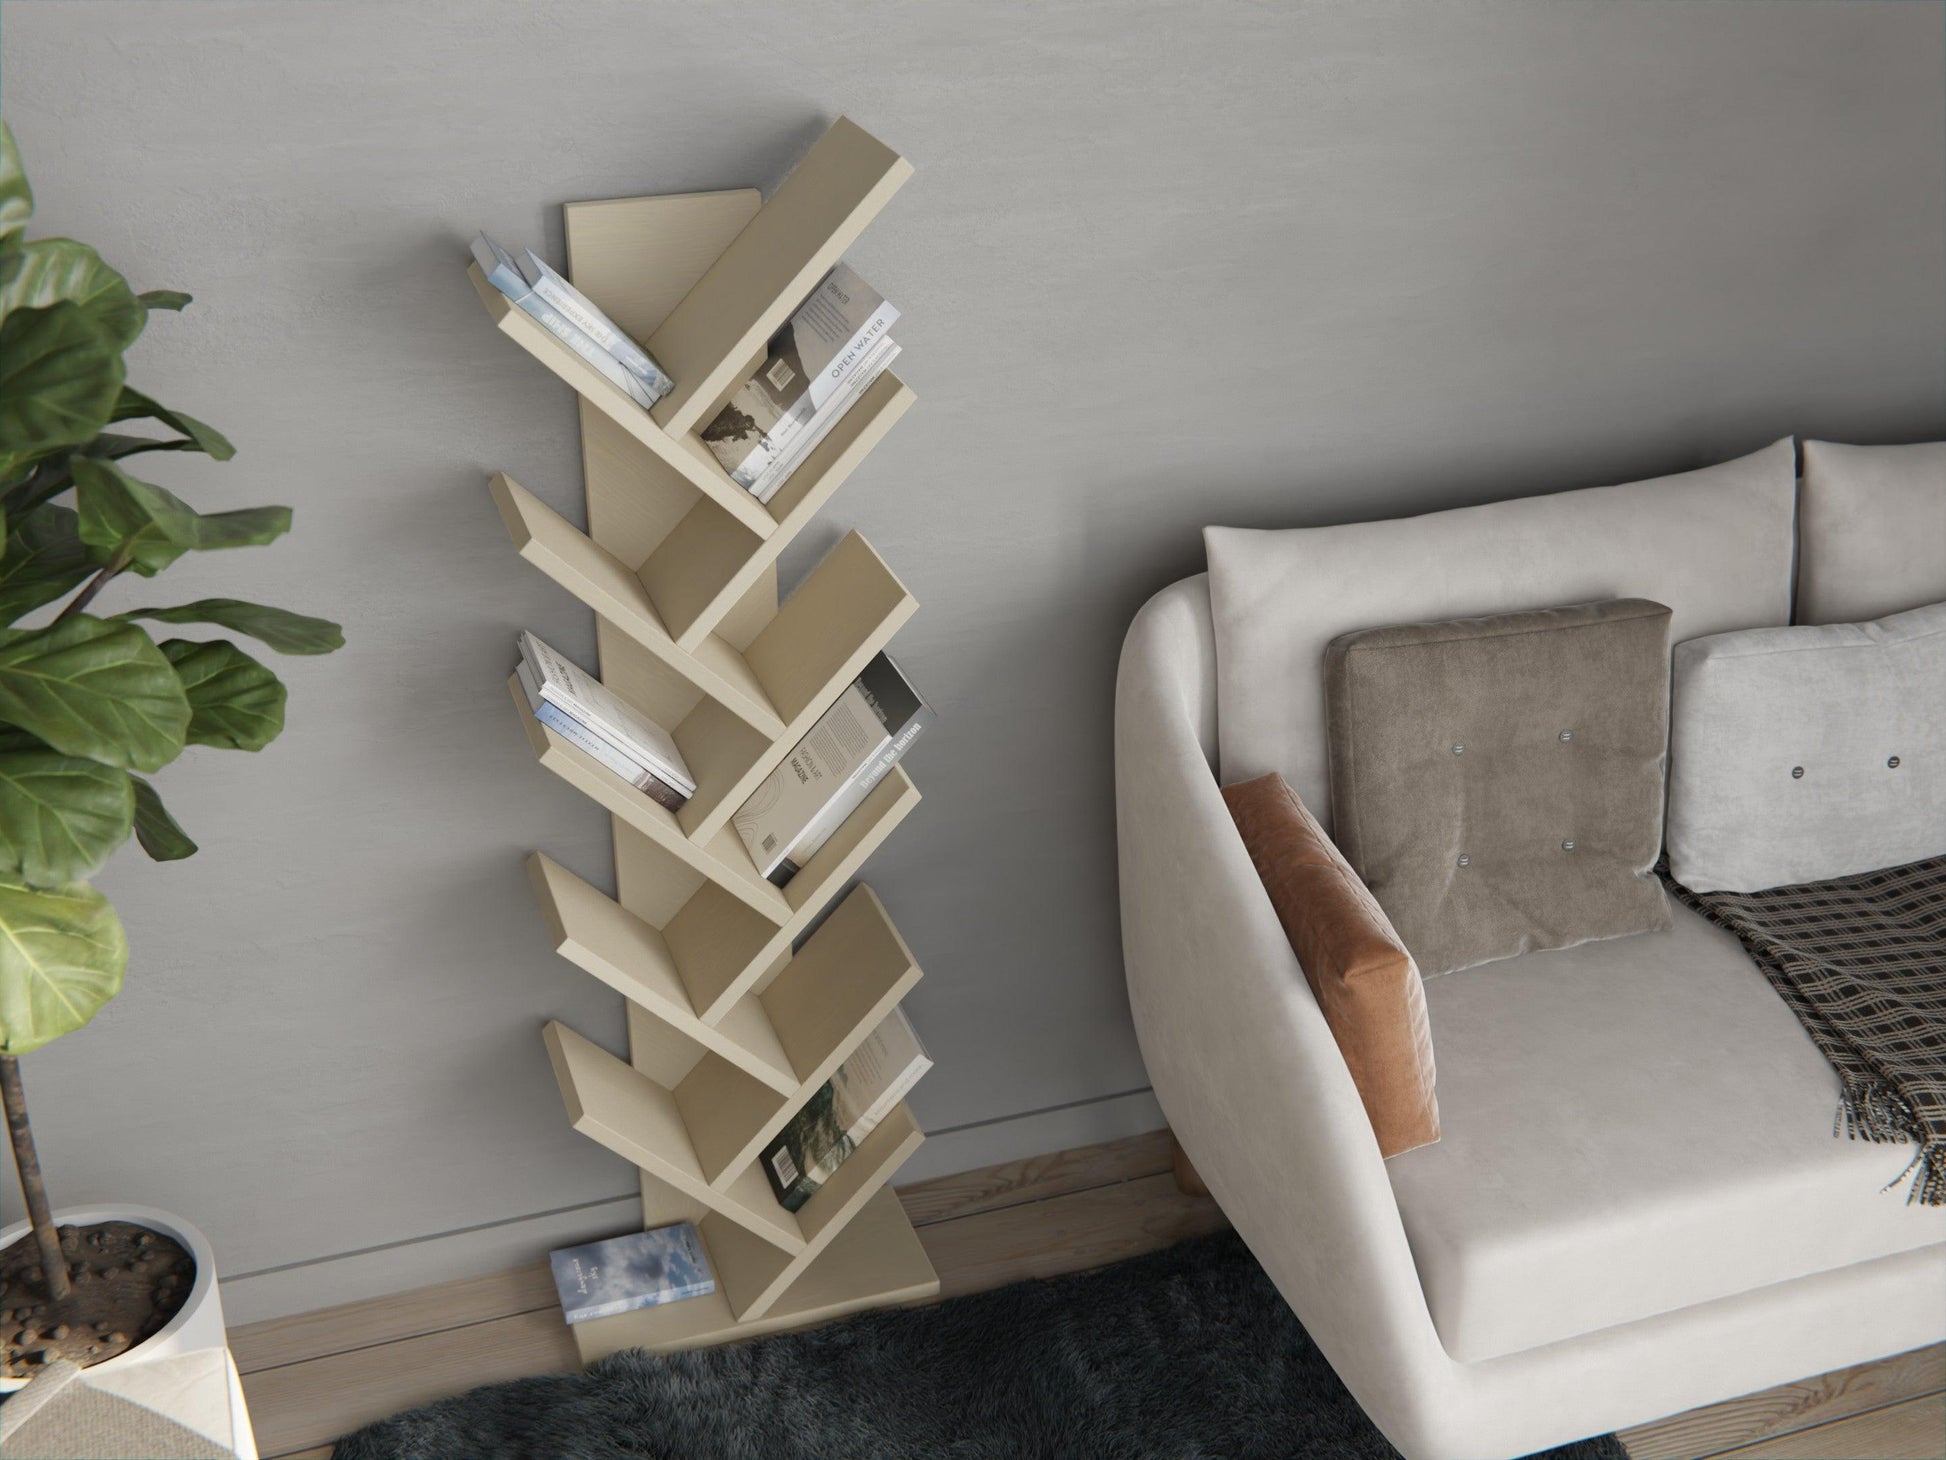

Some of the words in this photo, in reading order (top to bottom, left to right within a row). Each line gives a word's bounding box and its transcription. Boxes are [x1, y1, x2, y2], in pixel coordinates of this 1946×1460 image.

[542, 287, 585, 323] EXPERIENCE
[831, 351, 856, 379] OPEN
[855, 318, 886, 351] WATER
[791, 757, 809, 785] MAGAZINE
[859, 761, 887, 790] Beyond
[883, 747, 898, 766] the
[893, 721, 922, 753] horizon
